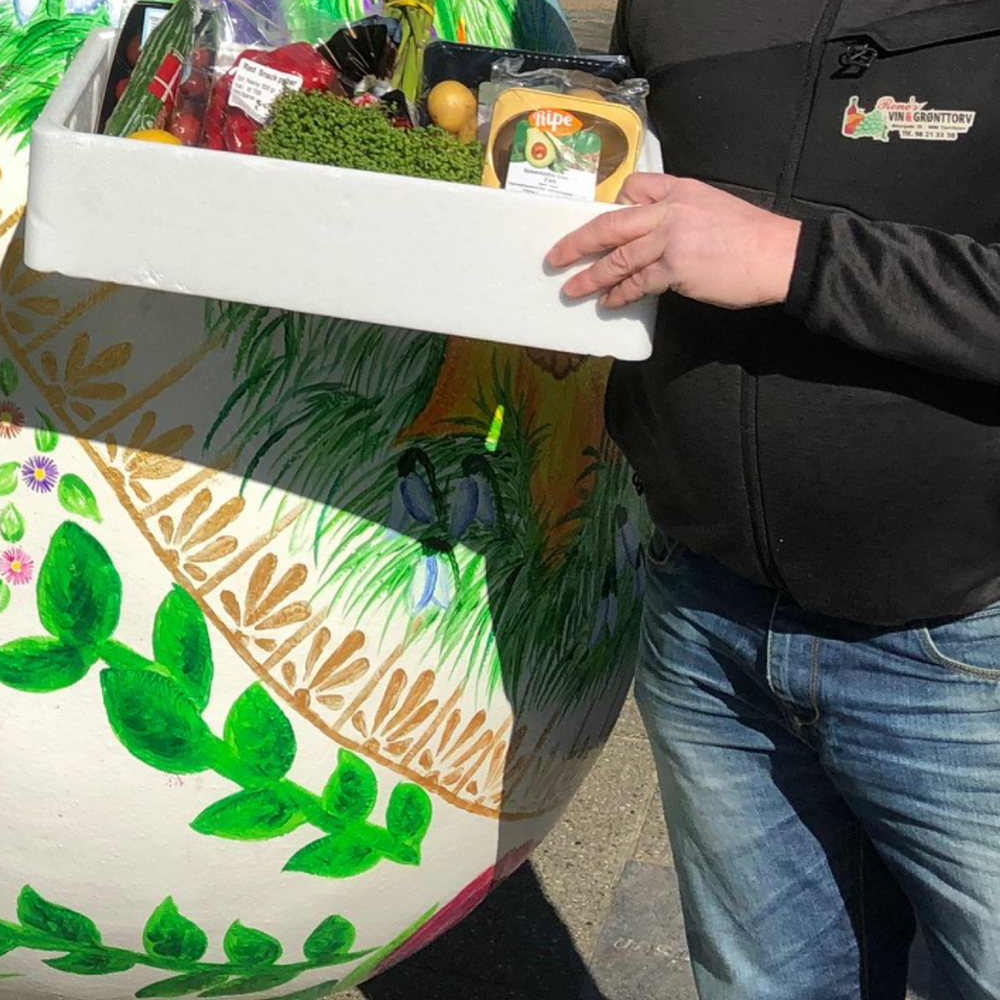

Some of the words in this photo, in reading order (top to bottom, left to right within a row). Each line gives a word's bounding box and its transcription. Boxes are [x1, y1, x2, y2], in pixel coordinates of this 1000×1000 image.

[258, 69, 277, 81] Snack
[534, 110, 573, 132] Ripe
[889, 112, 905, 122] VIN
[905, 112, 912, 122] &
[913, 112, 973, 124] GRØNTTORV
